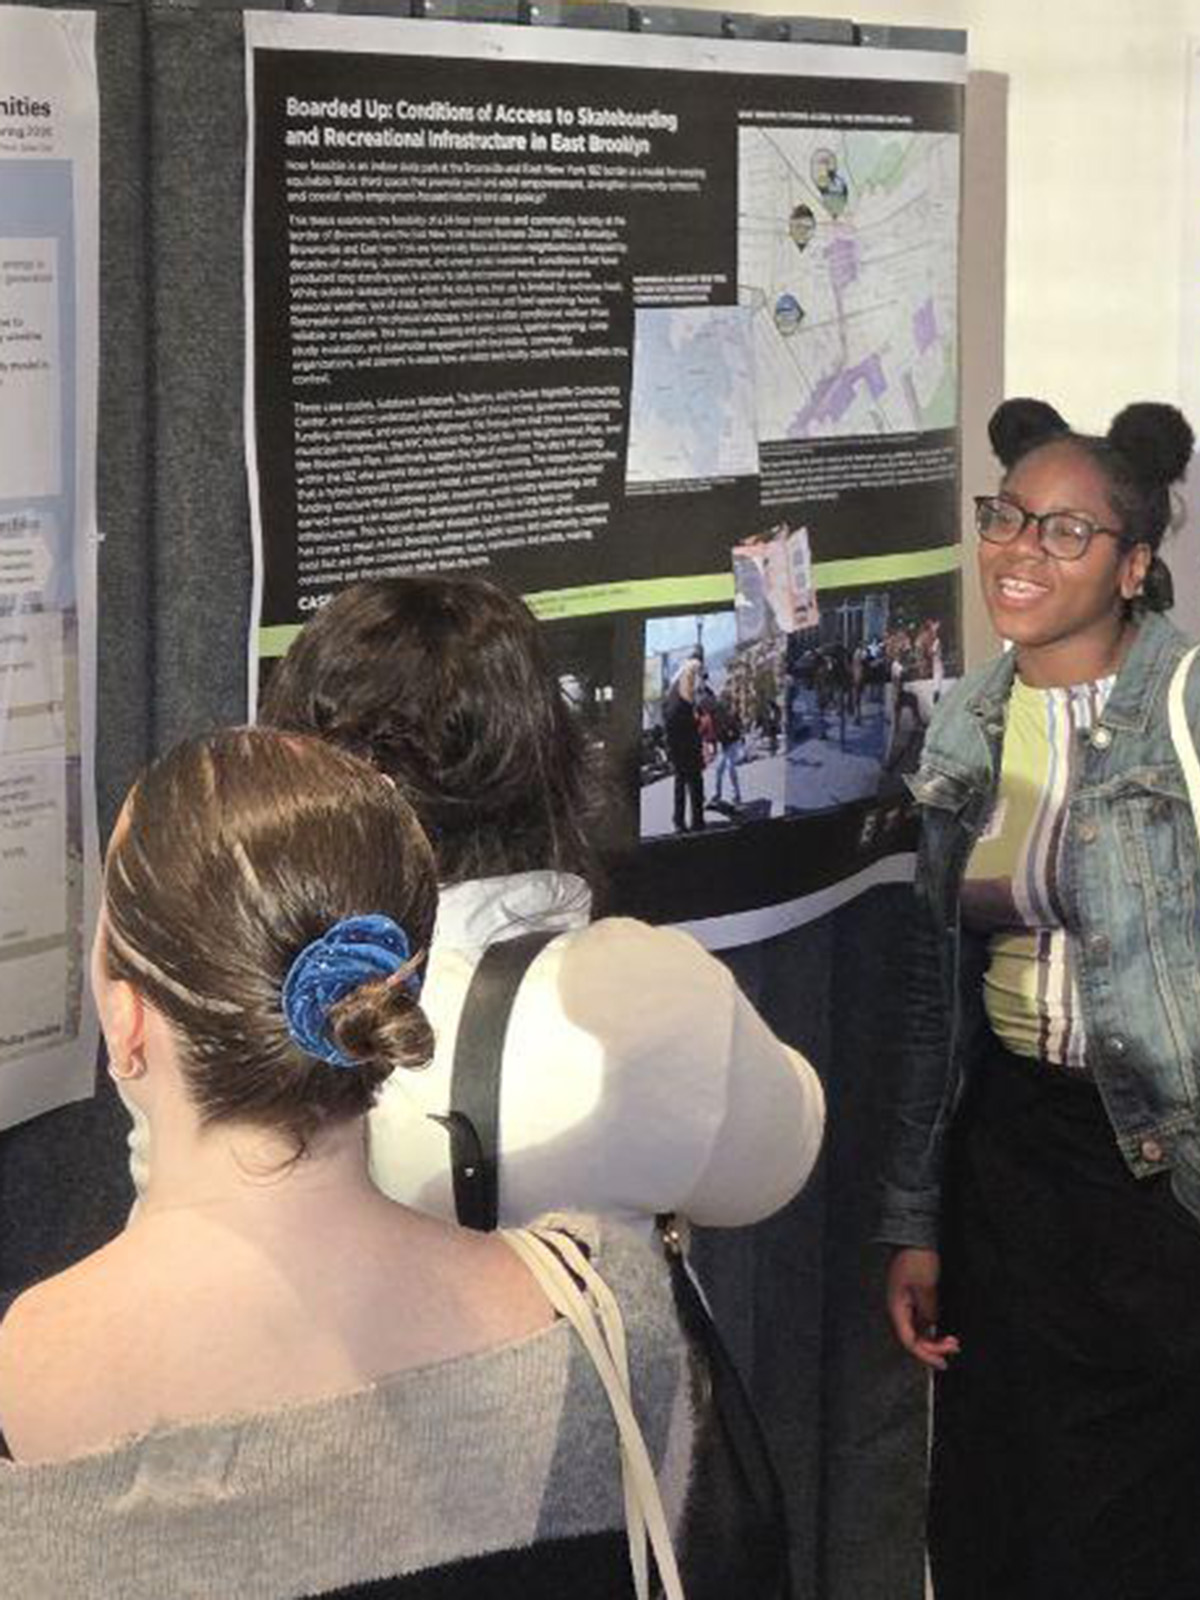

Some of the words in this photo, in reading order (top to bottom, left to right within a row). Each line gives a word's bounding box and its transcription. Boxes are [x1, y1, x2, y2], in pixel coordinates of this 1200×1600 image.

[286, 97, 361, 118] Boarded
[365, 99, 393, 122] Up:
[397, 101, 474, 121] Conditions
[477, 102, 493, 122] of
[495, 104, 552, 124] Access
[557, 107, 574, 125] to
[577, 107, 678, 133] Skateboarding
[285, 126, 320, 146] and
[323, 128, 425, 147] Recreational
[428, 130, 527, 150] Infrastructure
[530, 131, 548, 150] in
[550, 133, 586, 152] East
[588, 133, 651, 157] Brooklyn
